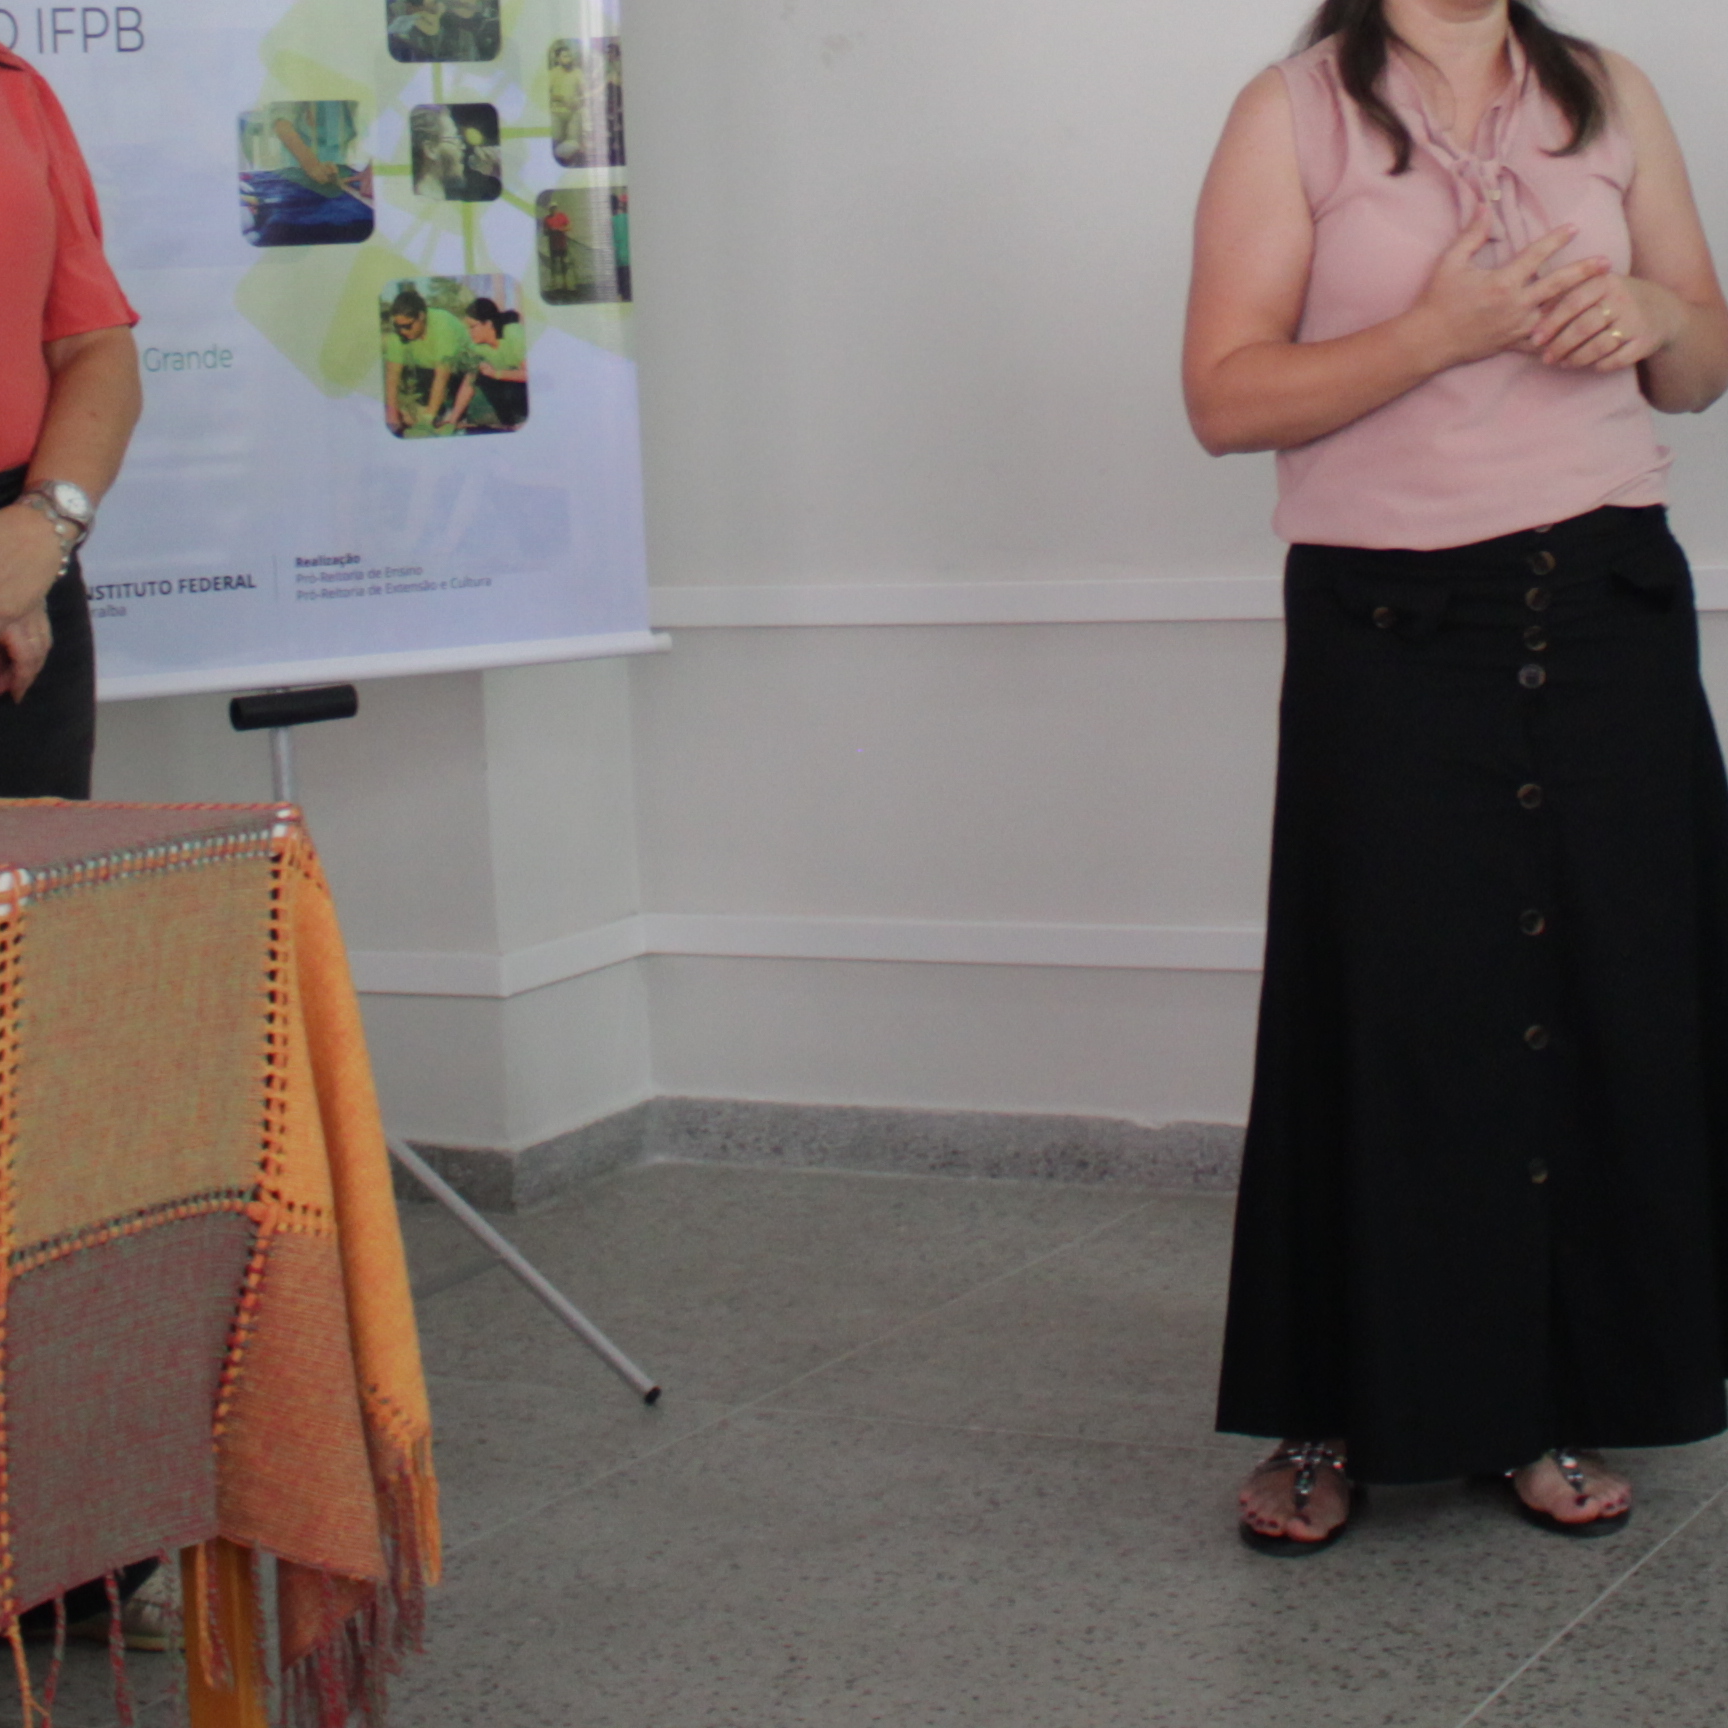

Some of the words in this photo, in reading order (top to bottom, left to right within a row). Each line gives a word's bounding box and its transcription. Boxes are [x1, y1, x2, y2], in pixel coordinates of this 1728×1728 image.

[36, 6, 146, 54] IFPB
[142, 343, 234, 372] Grande
[295, 553, 362, 569] Realização
[178, 574, 257, 594] FEDERAL
